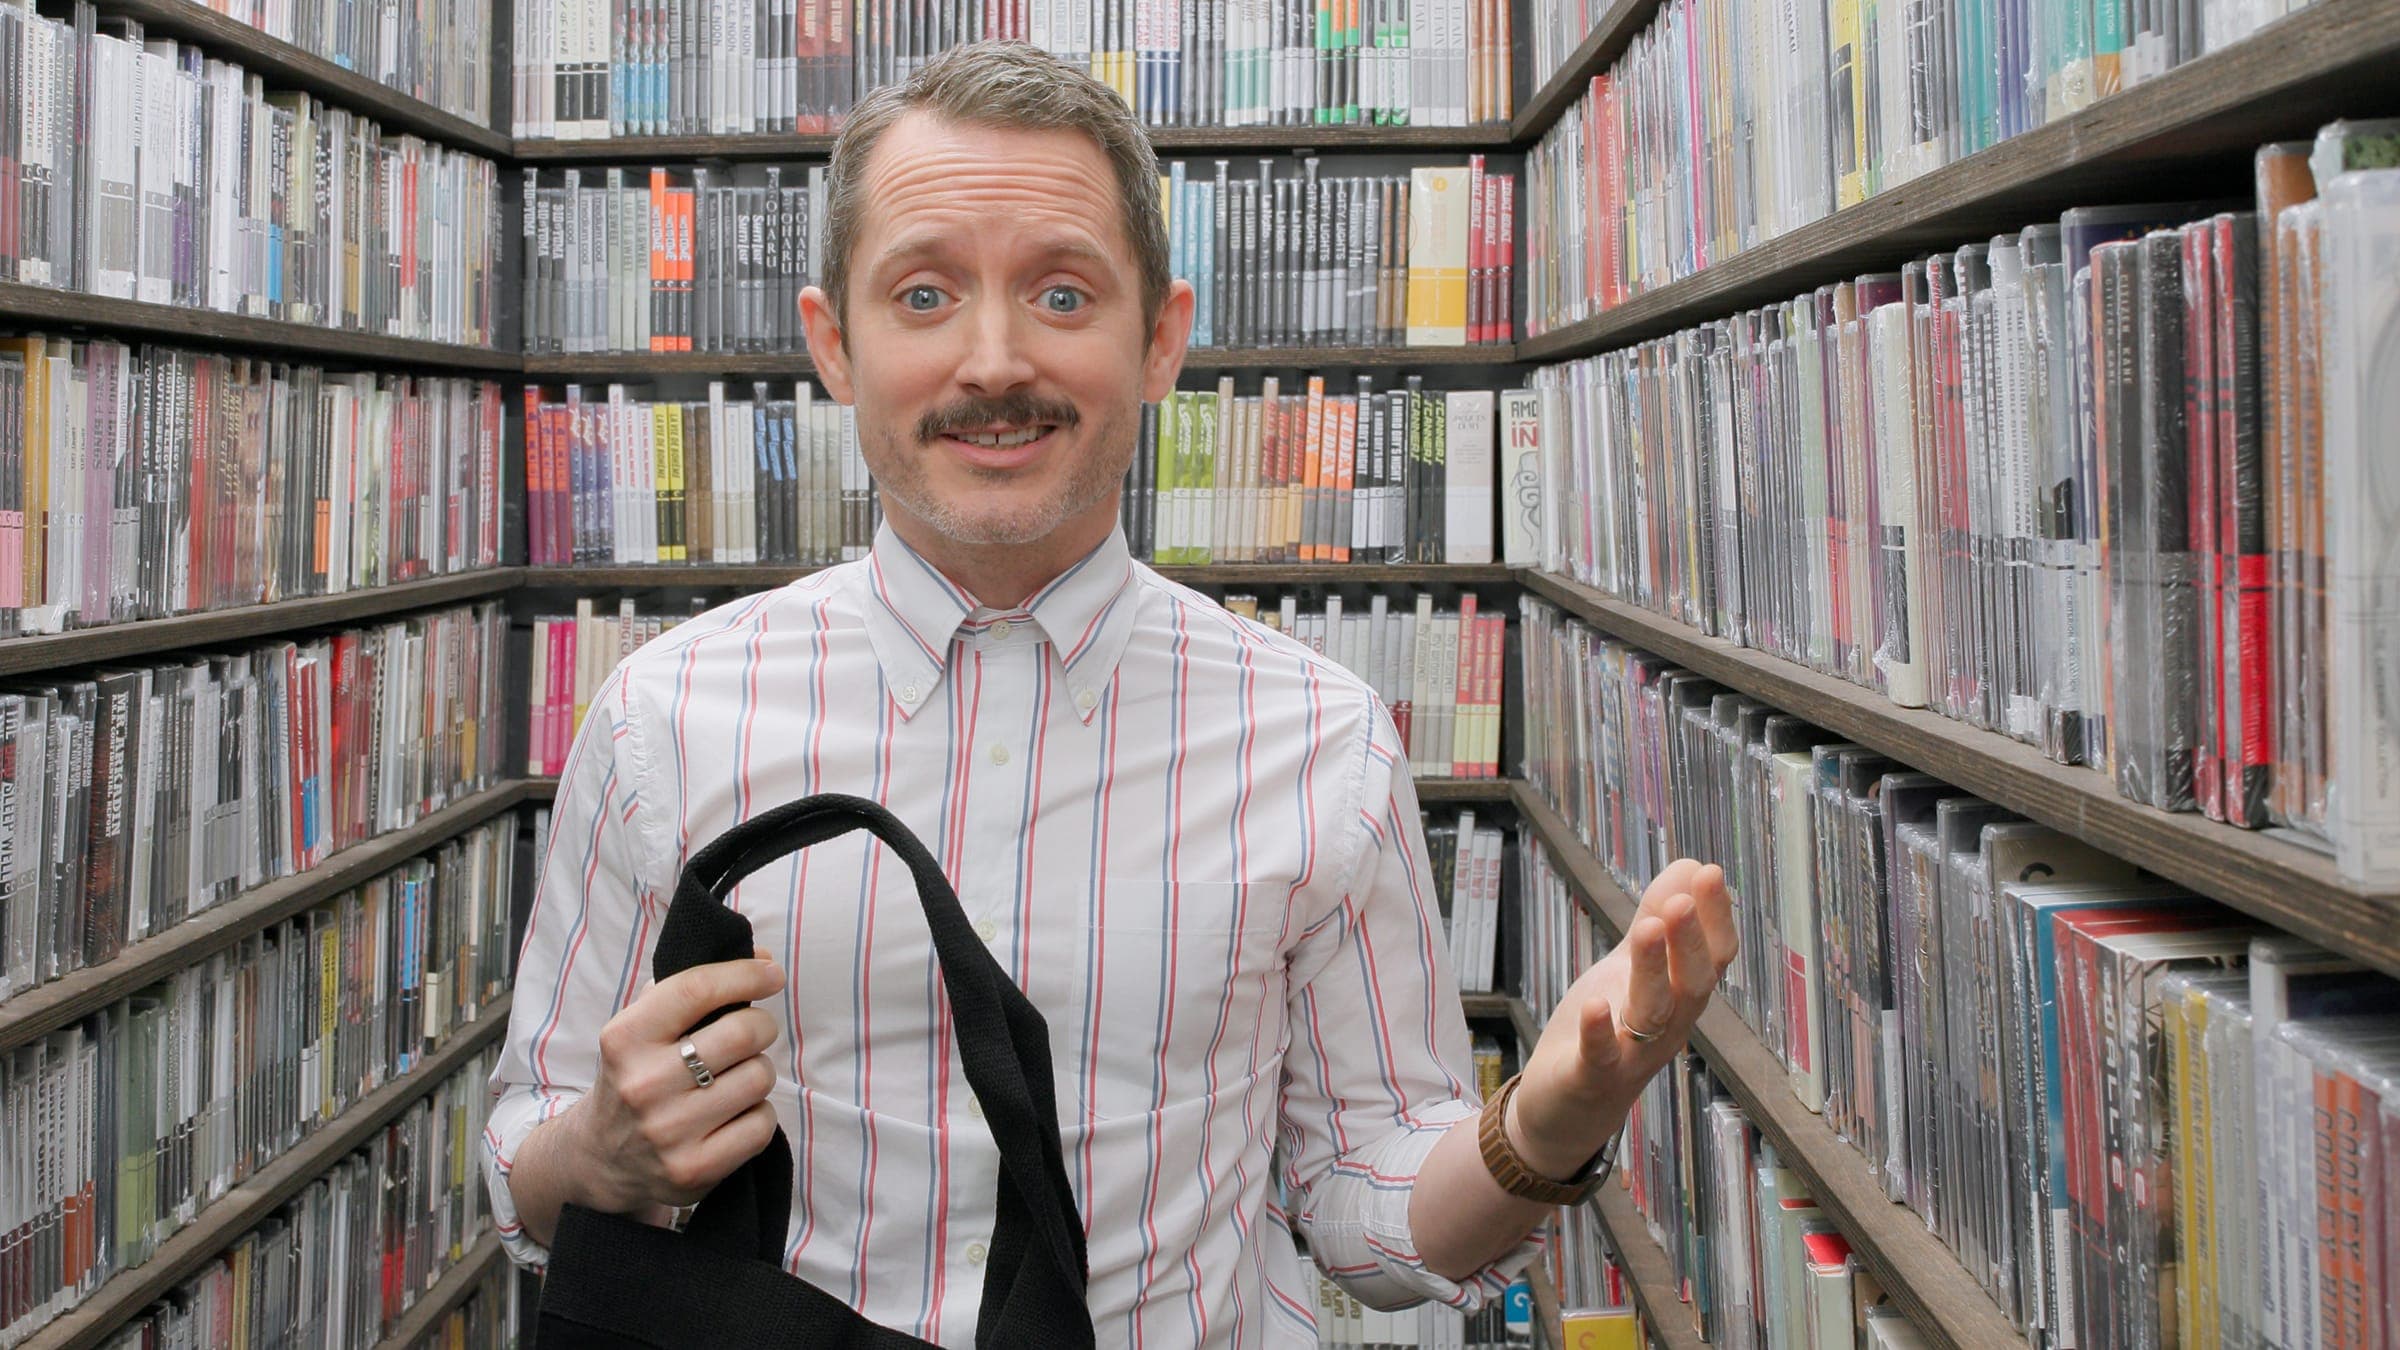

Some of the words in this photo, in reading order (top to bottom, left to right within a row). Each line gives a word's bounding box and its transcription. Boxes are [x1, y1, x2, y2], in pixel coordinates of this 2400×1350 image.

[742, 25, 752, 56] NOON
[566, 179, 577, 220] medium
[609, 176, 619, 197] LIFE
[1262, 194, 1273, 209] La
[1306, 183, 1317, 210] CITY
[1321, 193, 1332, 219] CITY
[1336, 191, 1347, 218] CITY
[580, 200, 592, 240] medium
[594, 196, 606, 239] medium
[623, 201, 635, 222] LIFE
[637, 200, 649, 219] LIFE
[1262, 209, 1273, 239] Notte
[1276, 210, 1287, 224] La
[1292, 209, 1303, 223] La
[566, 221, 577, 245] cool
[609, 213, 619, 247] SWEET
[766, 200, 778, 269] OHARU
[780, 212, 793, 275] OHARU
[795, 211, 808, 275] OHARU
[1276, 224, 1287, 252] Notte
[1292, 224, 1303, 252] Notte
[1306, 214, 1317, 253] LIGHTS
[1321, 223, 1332, 262] LIGHTS
[1336, 222, 1347, 260] LIGHTS
[580, 242, 592, 266] cool
[594, 240, 606, 263] cool
[623, 239, 635, 273] SWEET
[637, 236, 649, 271] SWEET
[2104, 278, 2115, 335] CITIZEN
[2120, 274, 2131, 333] CITIZEN
[143, 361, 153, 407] YOUTH
[2007, 335, 2018, 415] INCREDIBLE
[2018, 336, 2028, 418] INCREDIBLE
[2106, 349, 2116, 387] KANE
[2122, 346, 2133, 387] KANE
[155, 364, 166, 411] YOUTH
[164, 363, 174, 428] FIGHTING
[1358, 391, 1370, 399] A
[1307, 387, 1322, 456] JUDEX
[1358, 399, 1370, 423] HARD
[1374, 416, 1384, 437] HARD
[1391, 405, 1403, 430] HARD
[1410, 390, 1422, 462] SCANNERS
[142, 419, 153, 469] BEAST
[154, 425, 165, 473] BEAST
[1324, 407, 1339, 477] JUDEX
[1340, 411, 1354, 479] JUDEX
[1358, 423, 1370, 448] DAY'S
[1374, 437, 1384, 457] DAY'S
[1391, 430, 1403, 455] DAY'S
[1423, 399, 1434, 465] SCANNERS
[1434, 399, 1446, 465] SCANNERS
[163, 431, 172, 473] ELEGY
[1358, 449, 1370, 475] NIGHT
[1374, 457, 1384, 479] NIGHT
[1391, 455, 1403, 482] NIGHT
[2010, 418, 2020, 499] SHRINKING
[2020, 420, 2031, 501] SHRINKING
[2023, 502, 2032, 536] MAN
[2064, 575, 2074, 590] THE
[2065, 594, 2075, 638] CRITERION
[5, 704, 18, 742] THE
[2, 781, 18, 833] SLEEP
[110, 738, 126, 837] ARKADIN
[1, 836, 17, 882] WELL
[2315, 1106, 2337, 1260] COOLEY
[2338, 1108, 2361, 1263] COOLEY
[2061, 1214, 2070, 1231] THE
[2061, 1232, 2071, 1277] CRITERION
[2062, 1280, 2073, 1332] COLLECTION
[2343, 1277, 2362, 1350] HIG
